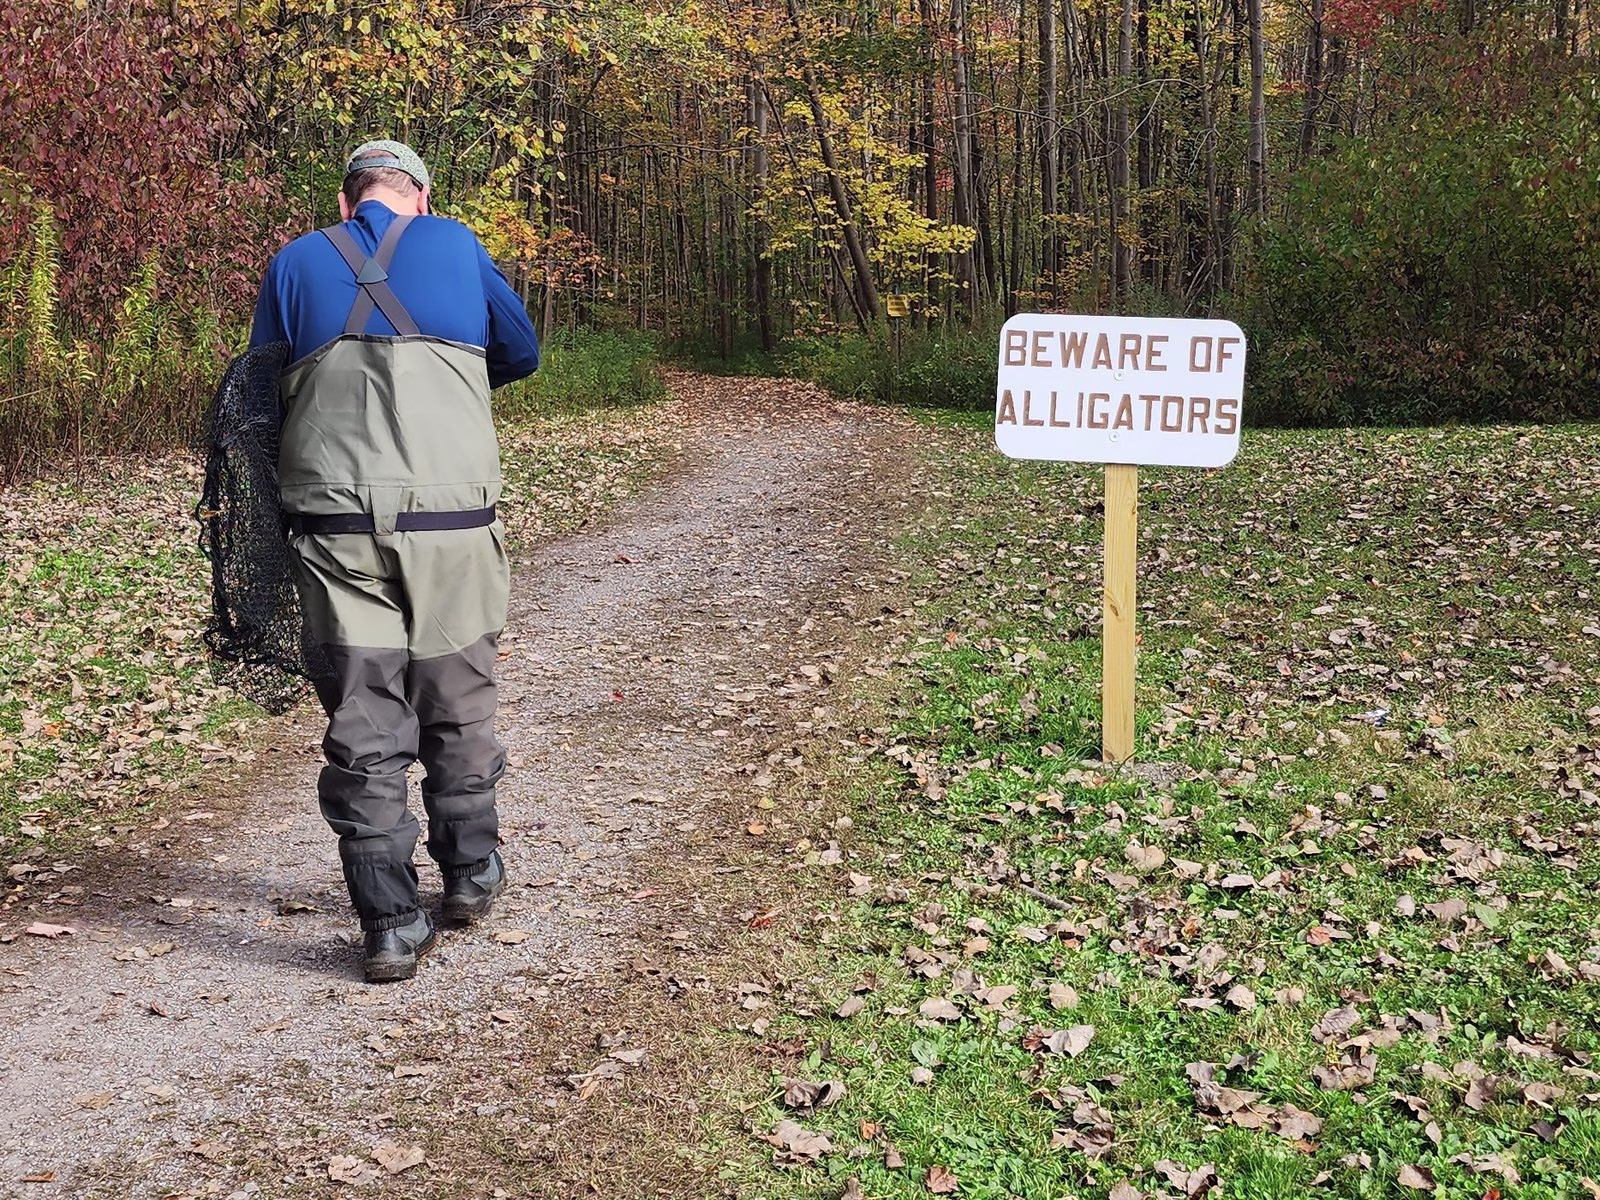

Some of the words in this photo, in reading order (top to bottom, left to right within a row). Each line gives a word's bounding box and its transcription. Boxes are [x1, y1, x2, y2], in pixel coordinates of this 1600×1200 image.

[1004, 329, 1169, 372] BEWARE
[1188, 336, 1240, 373] OF
[996, 389, 1239, 435] ALLIGATORS
